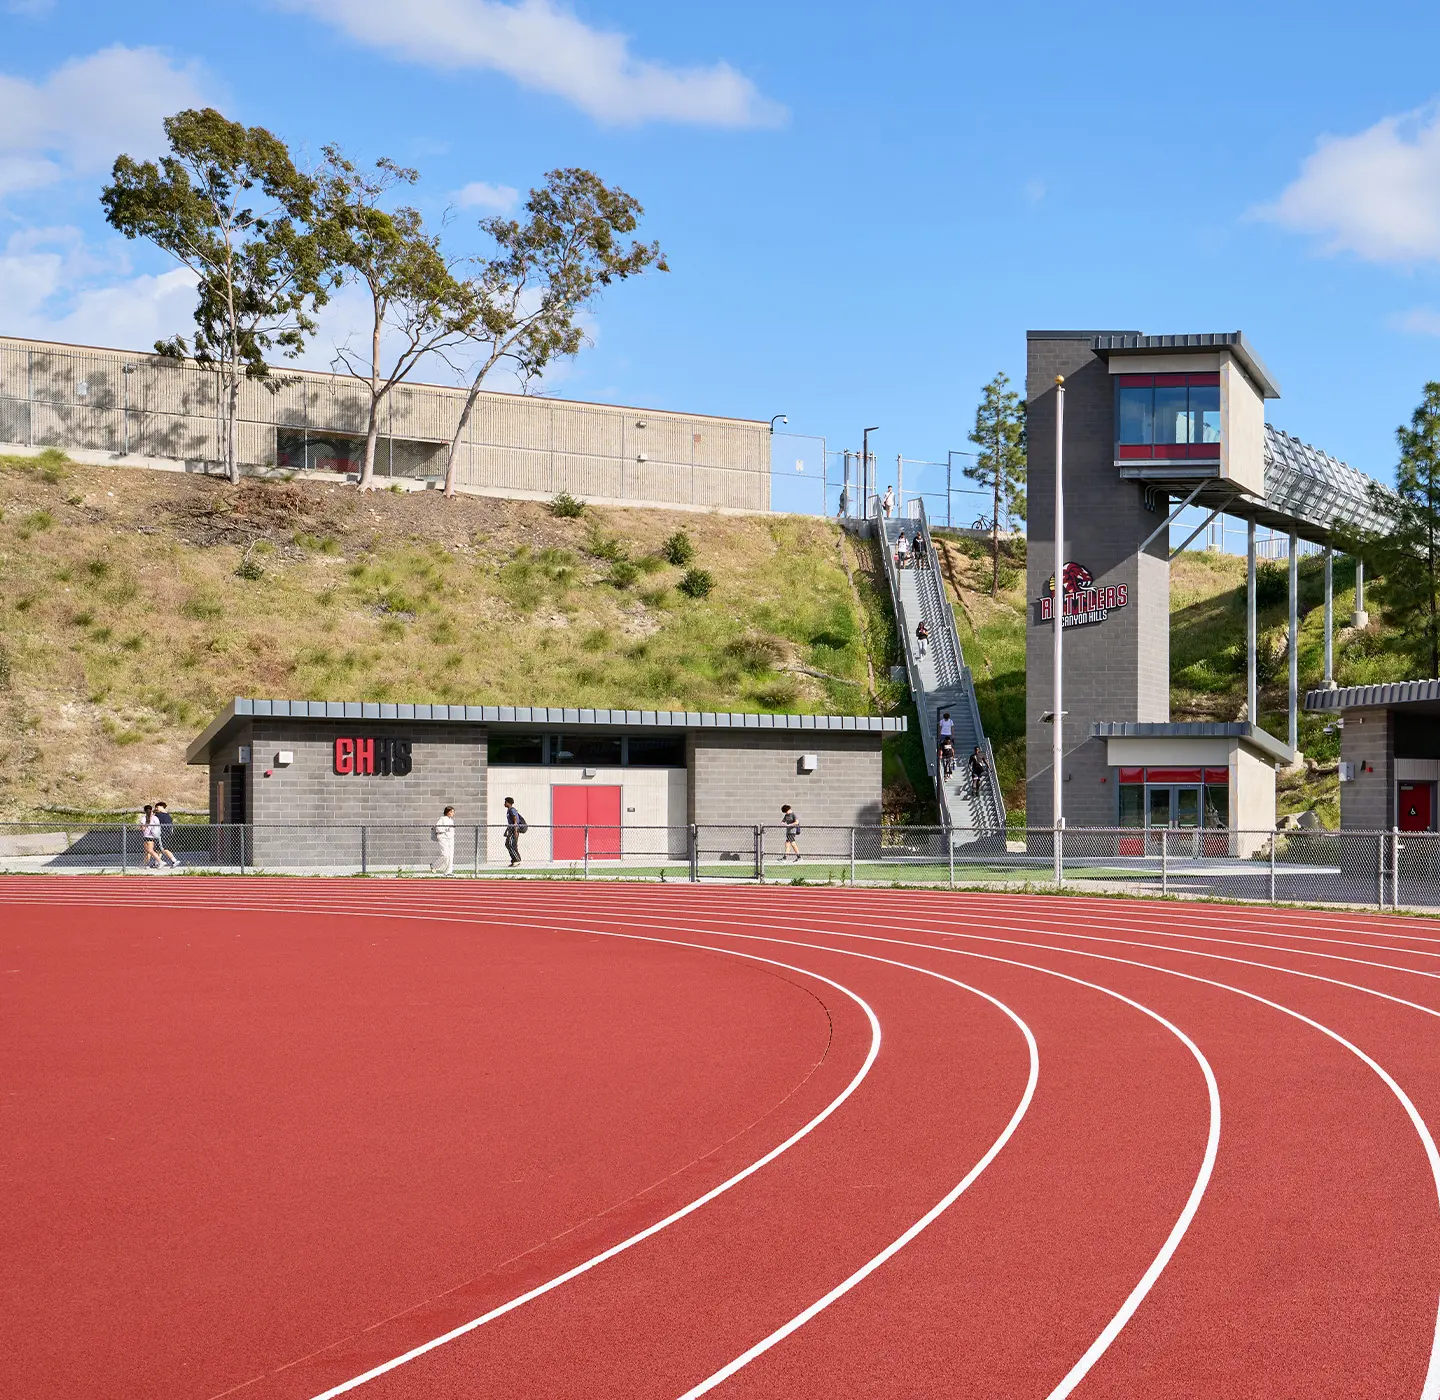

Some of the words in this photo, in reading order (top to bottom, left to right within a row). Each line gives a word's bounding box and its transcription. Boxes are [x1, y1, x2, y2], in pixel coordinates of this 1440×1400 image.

[1040, 584, 1128, 620] RTTLERS
[1061, 612, 1088, 627] CANYON
[1088, 609, 1108, 623] HILLS
[333, 737, 412, 777] CHHS
